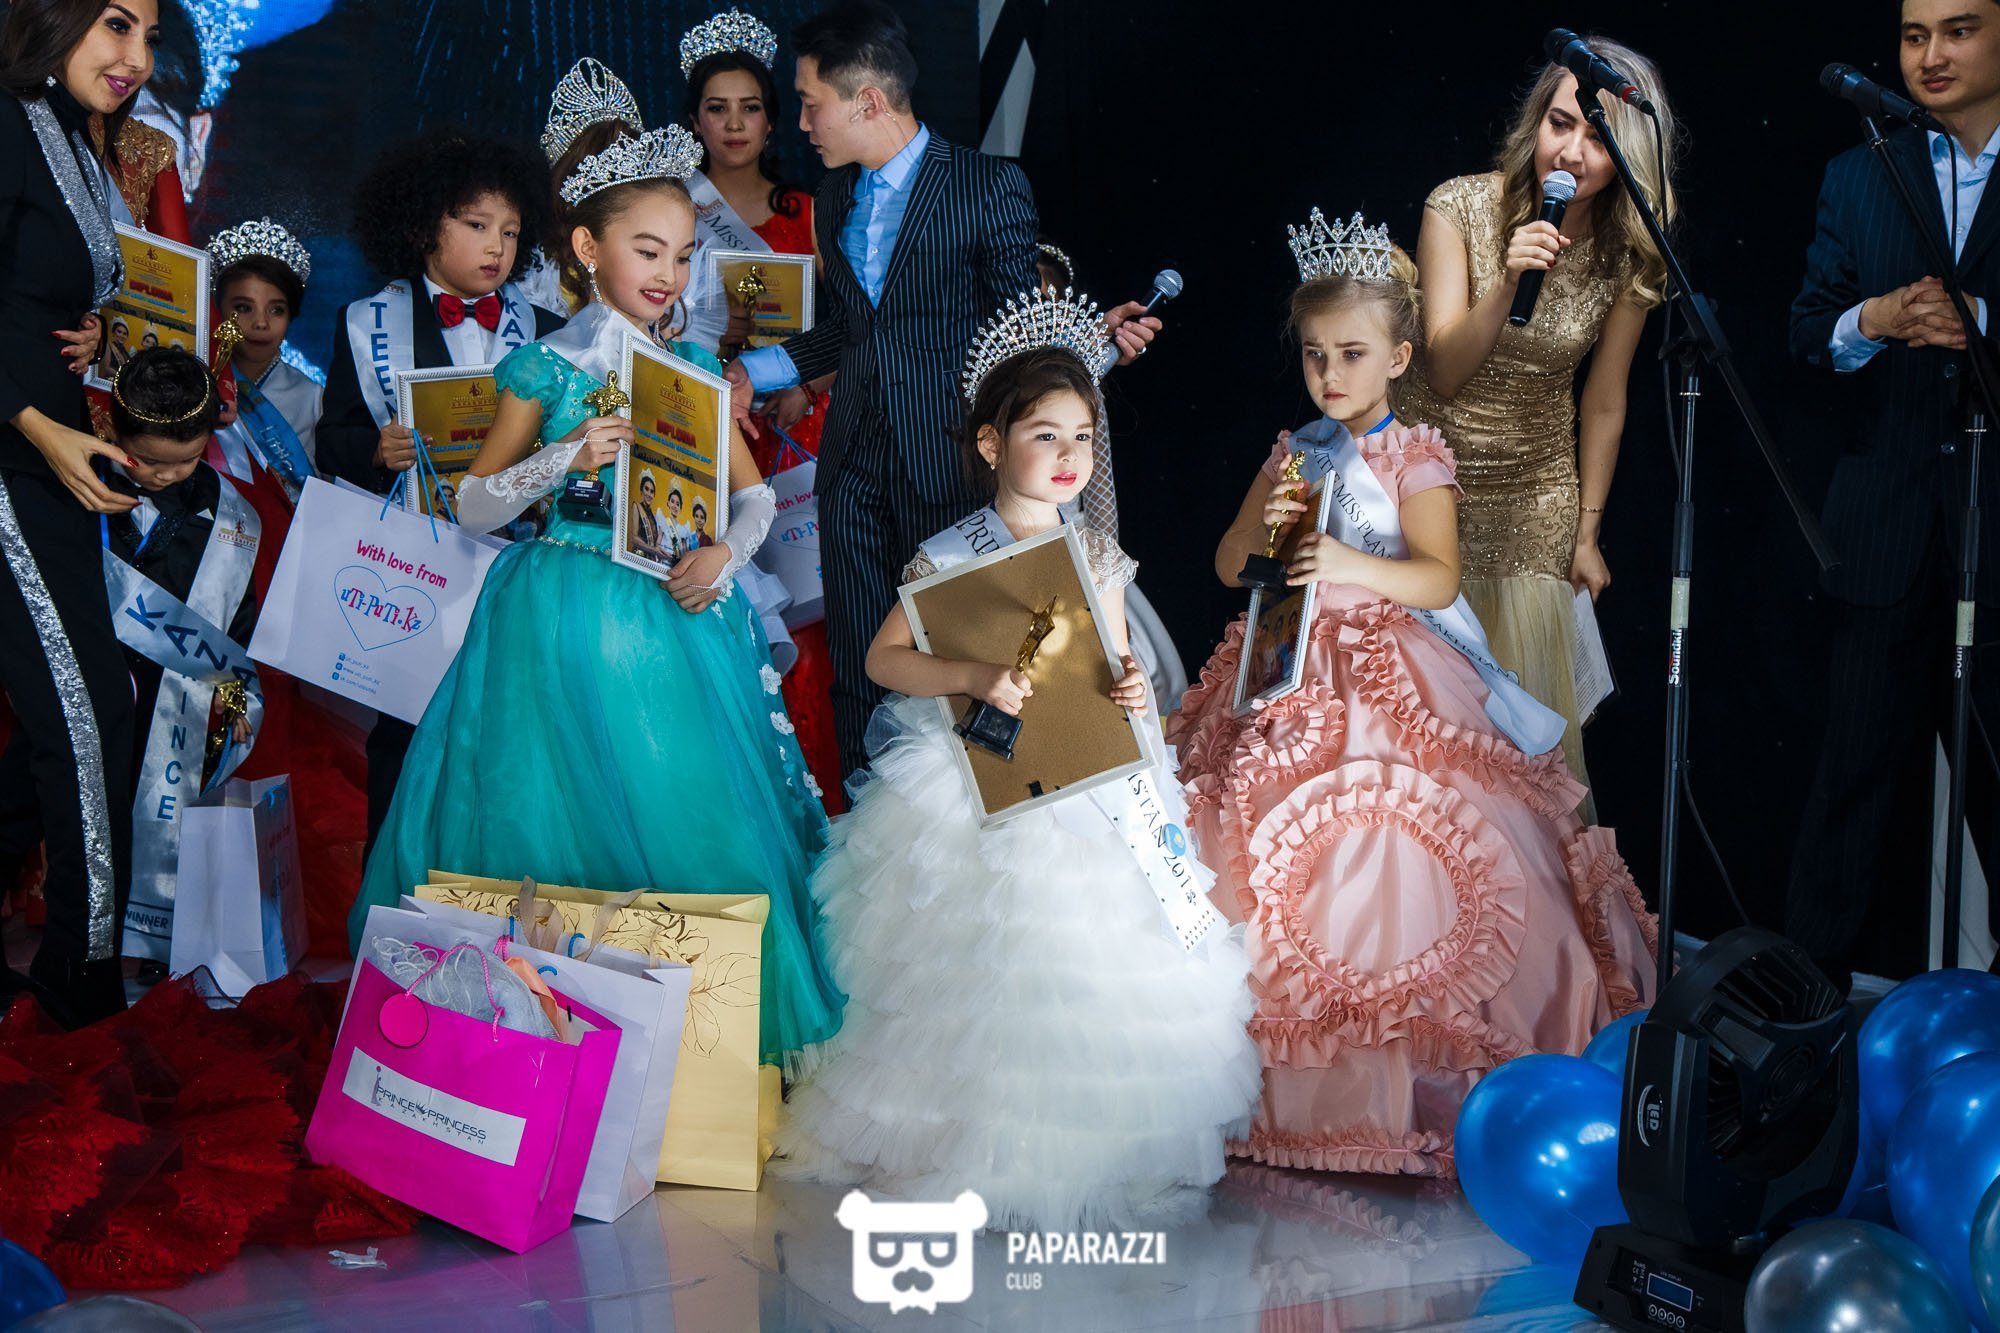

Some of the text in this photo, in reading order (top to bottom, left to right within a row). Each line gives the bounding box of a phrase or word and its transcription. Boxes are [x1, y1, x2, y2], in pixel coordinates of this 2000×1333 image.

[1333, 484, 1365, 523] MISS
[357, 539, 448, 589] With love from
[376, 1086, 487, 1140] PRINCE PRINCESS
[378, 1097, 484, 1145] KAZAKHSTAN
[1646, 1103, 1660, 1131] LED
